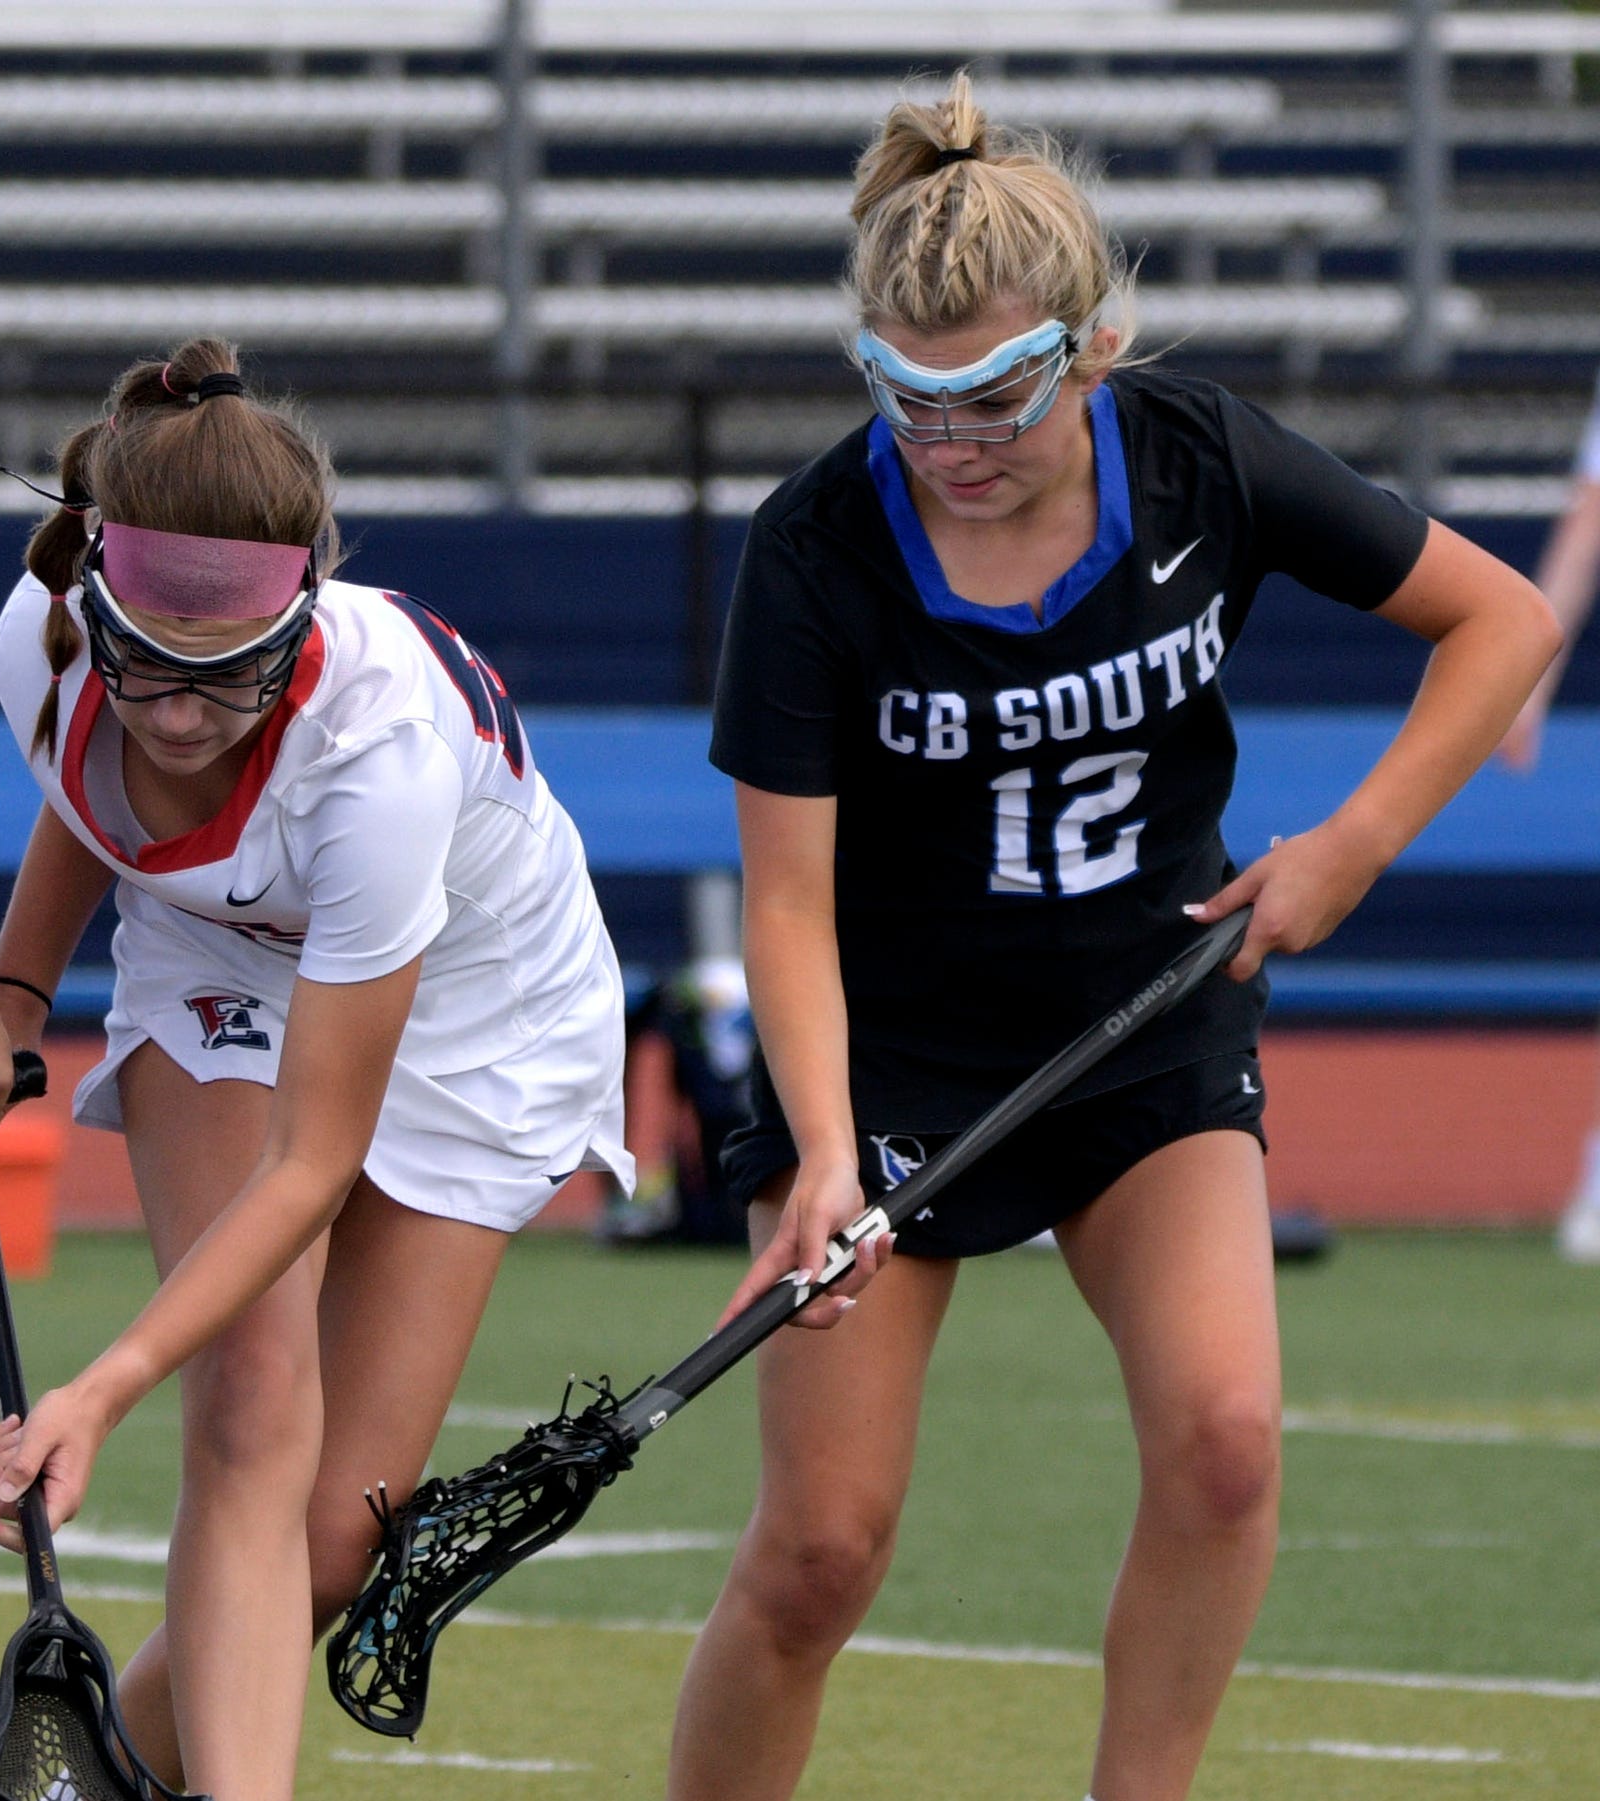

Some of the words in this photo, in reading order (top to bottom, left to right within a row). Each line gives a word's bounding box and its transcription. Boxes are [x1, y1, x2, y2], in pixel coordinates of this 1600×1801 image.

[878, 688, 970, 760] CB
[994, 592, 1225, 751] SOUTH
[987, 750, 1150, 895] 12
